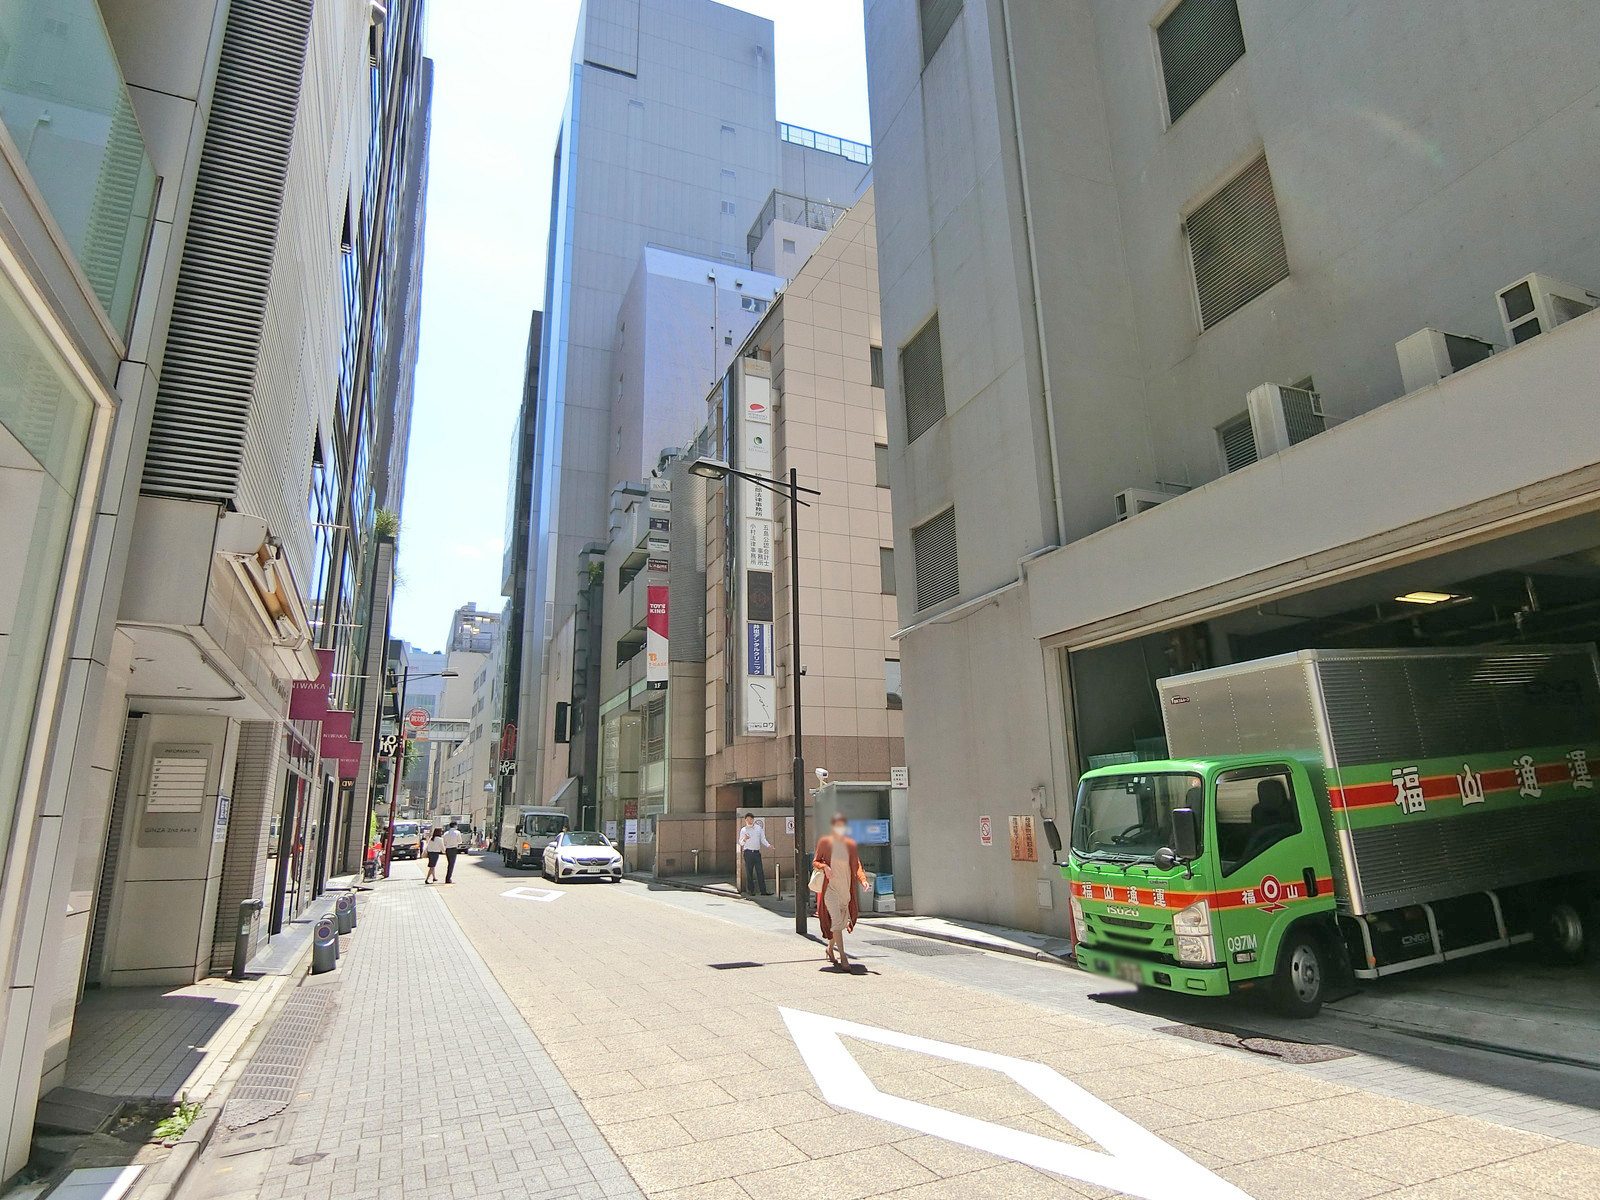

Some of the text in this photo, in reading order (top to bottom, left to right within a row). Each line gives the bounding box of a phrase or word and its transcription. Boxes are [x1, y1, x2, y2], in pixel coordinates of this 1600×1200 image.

[1391, 750, 1593, 815] 福山通運
[1082, 881, 1167, 907] 福山通運
[1241, 884, 1299, 905] 福 山
[1106, 904, 1140, 918] ISUZU
